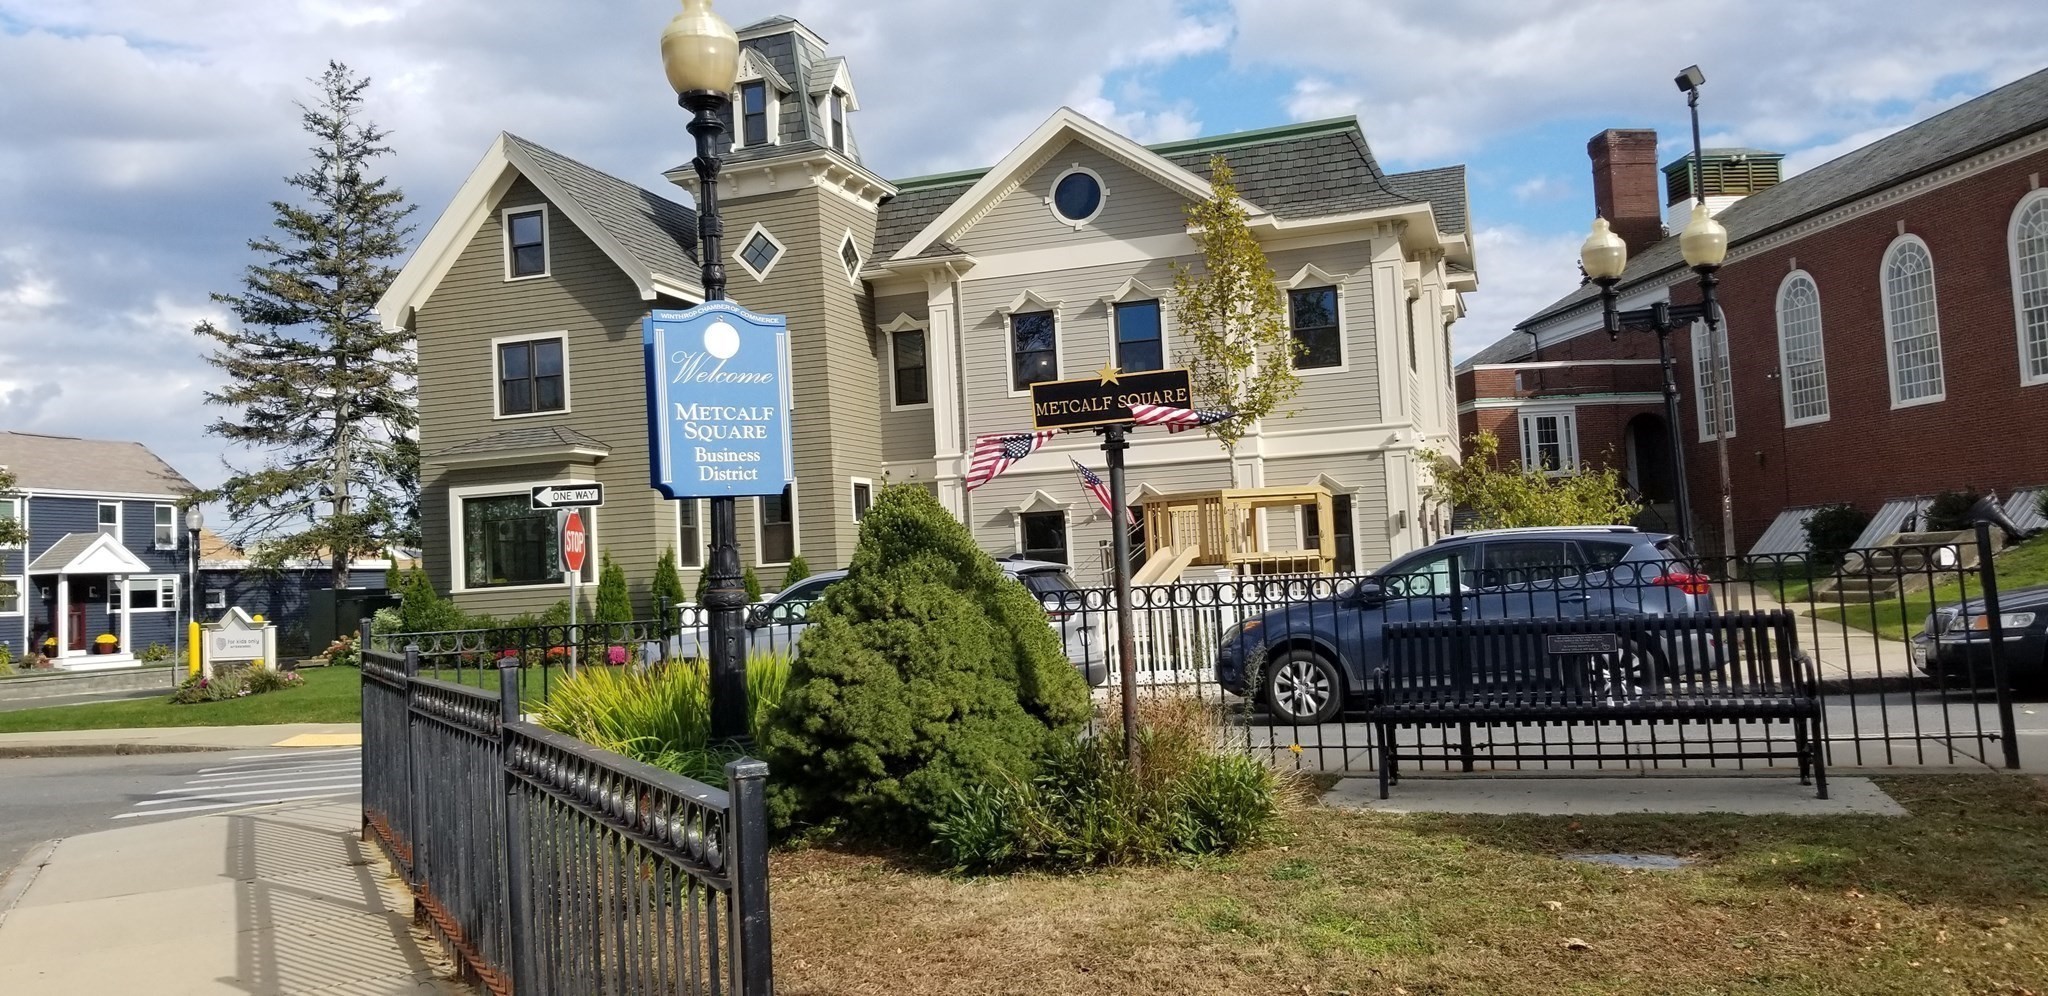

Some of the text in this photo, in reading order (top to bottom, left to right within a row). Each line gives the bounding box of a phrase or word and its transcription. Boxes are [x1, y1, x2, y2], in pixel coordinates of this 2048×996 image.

[660, 303, 780, 324] WINTHROP CHAMBER OF COMMERCE
[671, 350, 775, 384] Welcome
[1035, 388, 1188, 417] METCALF SQUARE
[694, 446, 761, 463] Business
[698, 465, 759, 481] District
[552, 490, 595, 501] ONE WAY
[566, 530, 584, 553] STOP
